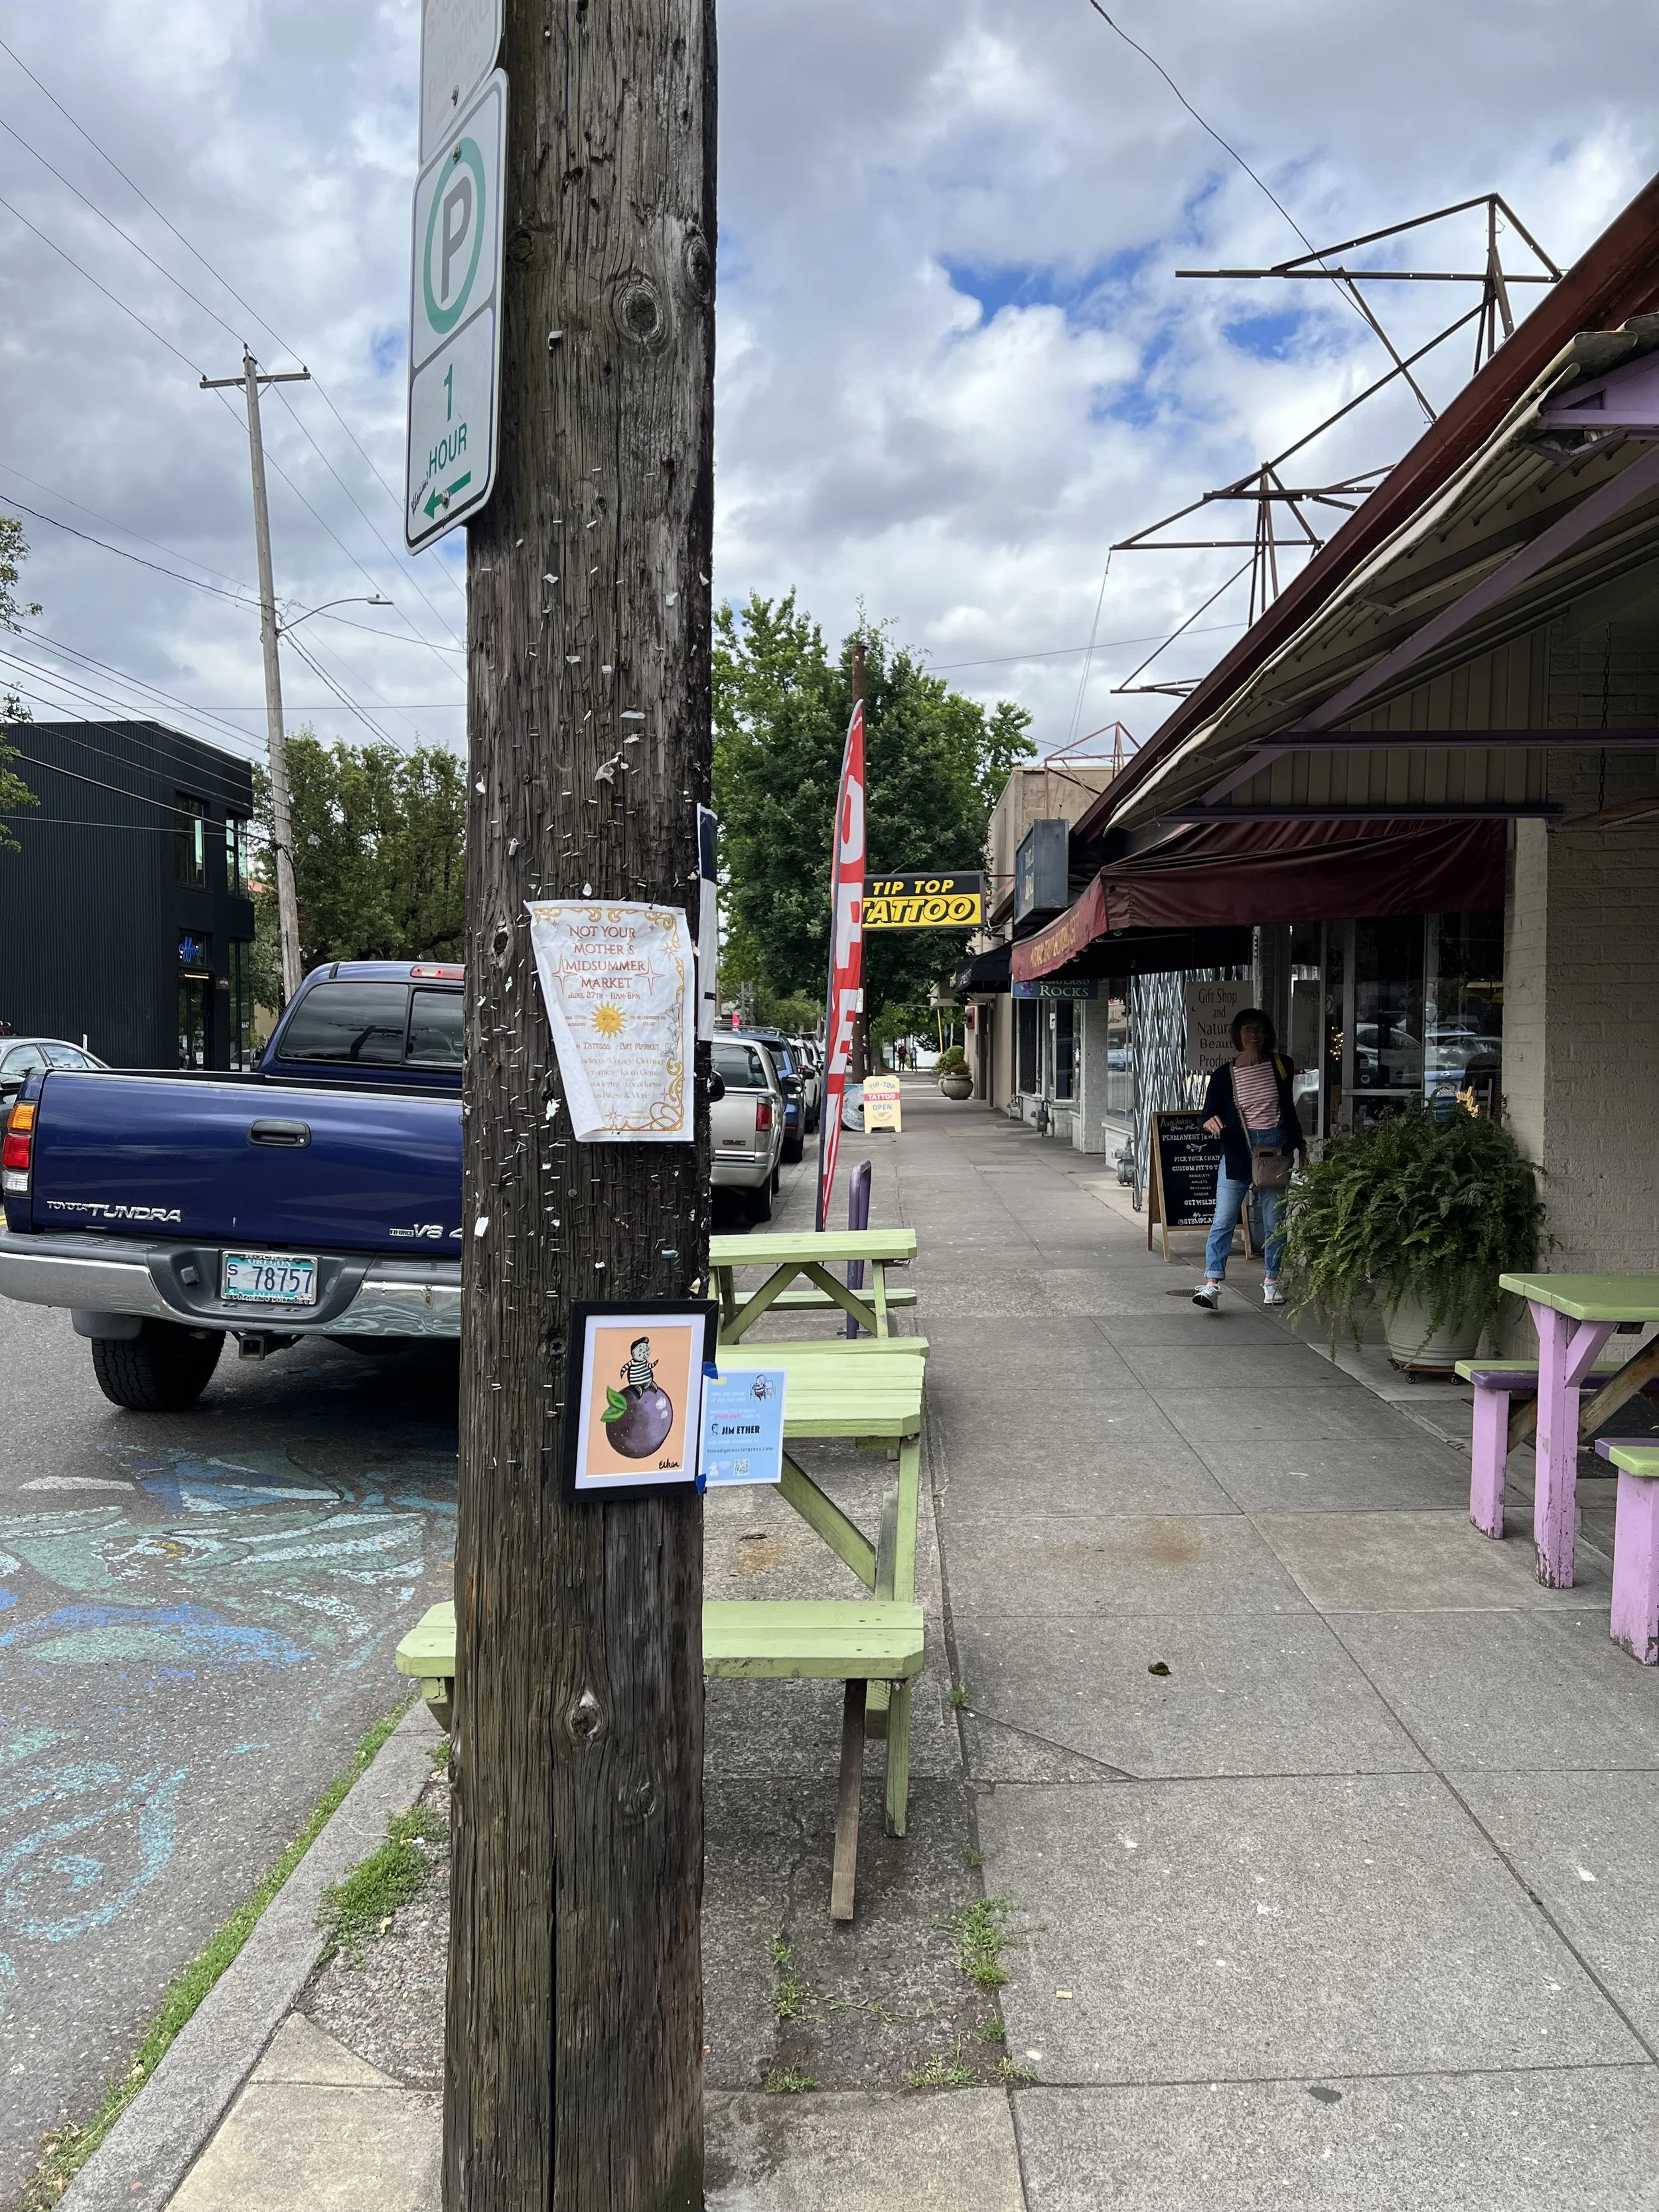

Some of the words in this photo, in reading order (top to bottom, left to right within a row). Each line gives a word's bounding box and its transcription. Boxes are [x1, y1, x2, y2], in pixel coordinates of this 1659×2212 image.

[441, 176, 472, 304] P
[443, 363, 453, 422] 1
[429, 422, 467, 479] HOUR
[873, 881, 904, 895] TIP
[914, 879, 954, 894] TOP
[567, 924, 598, 938] NOT
[601, 926, 636, 938] YOUR
[564, 959, 646, 972] MIDSUMMER
[579, 976, 632, 990] MARKET
[1039, 985, 1089, 997] ROCKS
[1198, 988, 1214, 1003] Gift
[1216, 988, 1238, 1007] Shop
[1212, 1005, 1226, 1019] and
[1197, 1021, 1232, 1035] Natur
[1200, 1037, 1234, 1049] Beaut
[1199, 1054, 1234, 1068] Produc
[1160, 1116, 1192, 1128] Available
[46, 1201, 89, 1211] TOYOTA
[88, 1203, 181, 1223] TUNDRA
[413, 1224, 444, 1239] V8
[248, 1258, 292, 1267] OREGON
[252, 1266, 313, 1294] 78757
[722, 1426, 735, 1435] JIM
[736, 1426, 760, 1434] ETHER
